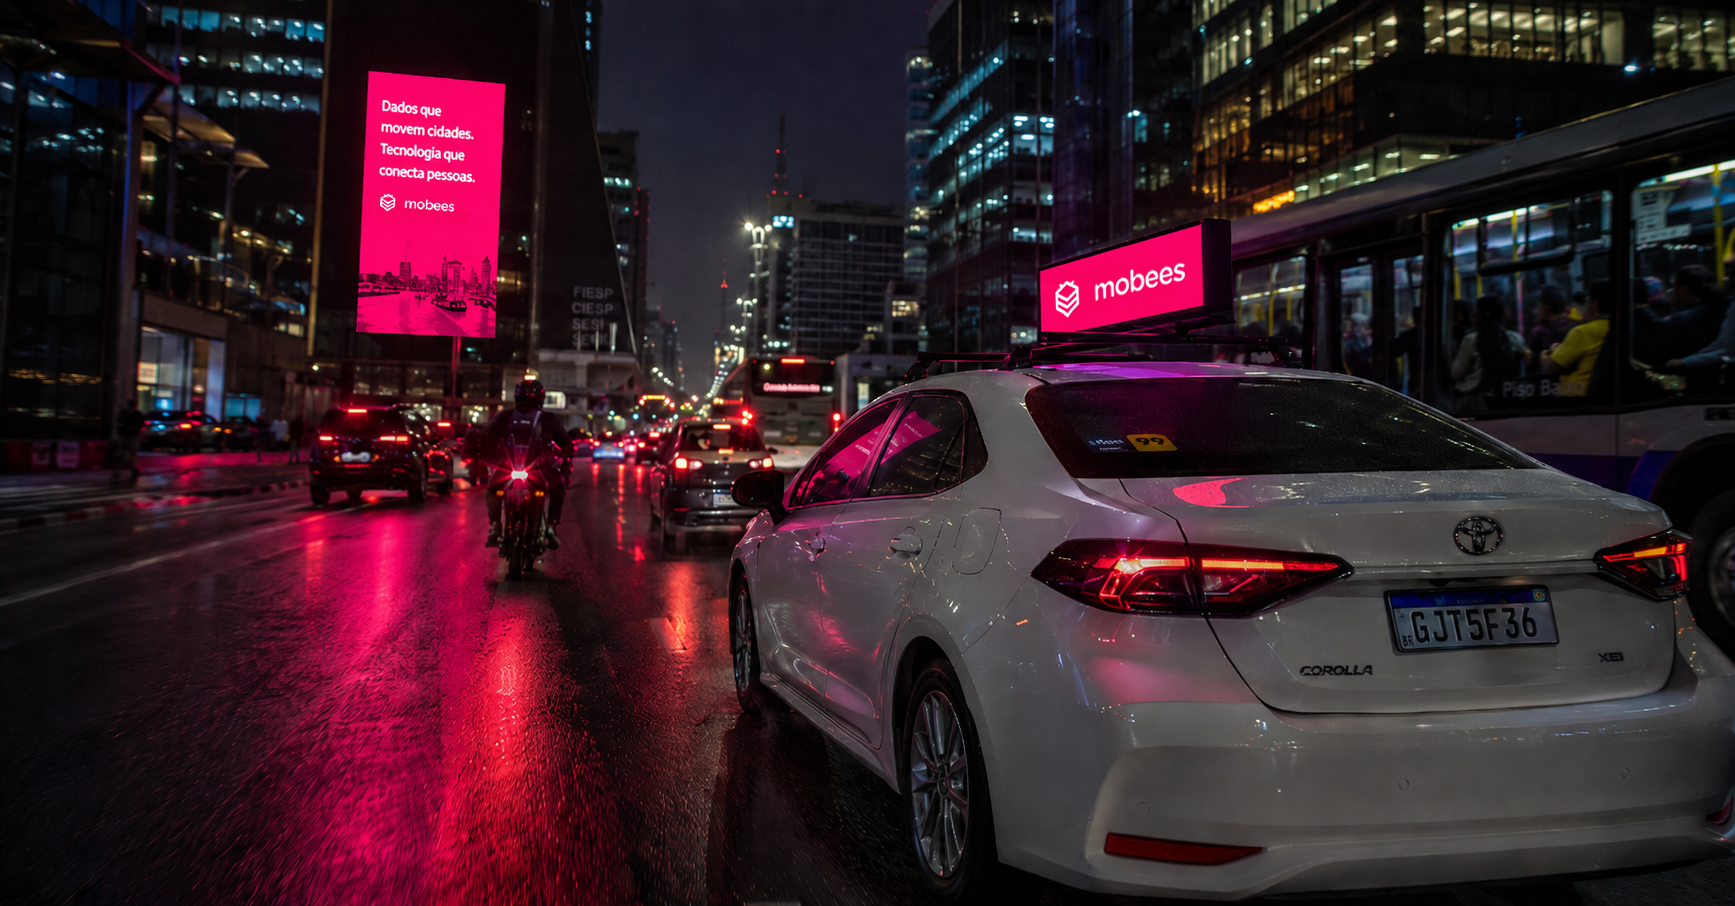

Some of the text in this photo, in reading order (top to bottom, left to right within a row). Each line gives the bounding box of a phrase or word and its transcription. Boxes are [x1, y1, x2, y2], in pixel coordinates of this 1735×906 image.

[381, 99, 442, 119] Dados que
[381, 123, 474, 140] movem cidades.
[380, 142, 466, 163] Tecnologia que
[379, 166, 475, 183] conecta pessoas.
[404, 199, 455, 212] mobees
[1094, 262, 1186, 301] mobees
[573, 285, 614, 299] FIESP
[571, 301, 614, 315] CIESP
[571, 317, 604, 331] SESI
[1502, 380, 1535, 398] Piso
[1135, 437, 1165, 445] 99
[1410, 607, 1537, 643] GJT5F36
[1402, 635, 1414, 647] BR
[1299, 664, 1373, 676] COROLLA
